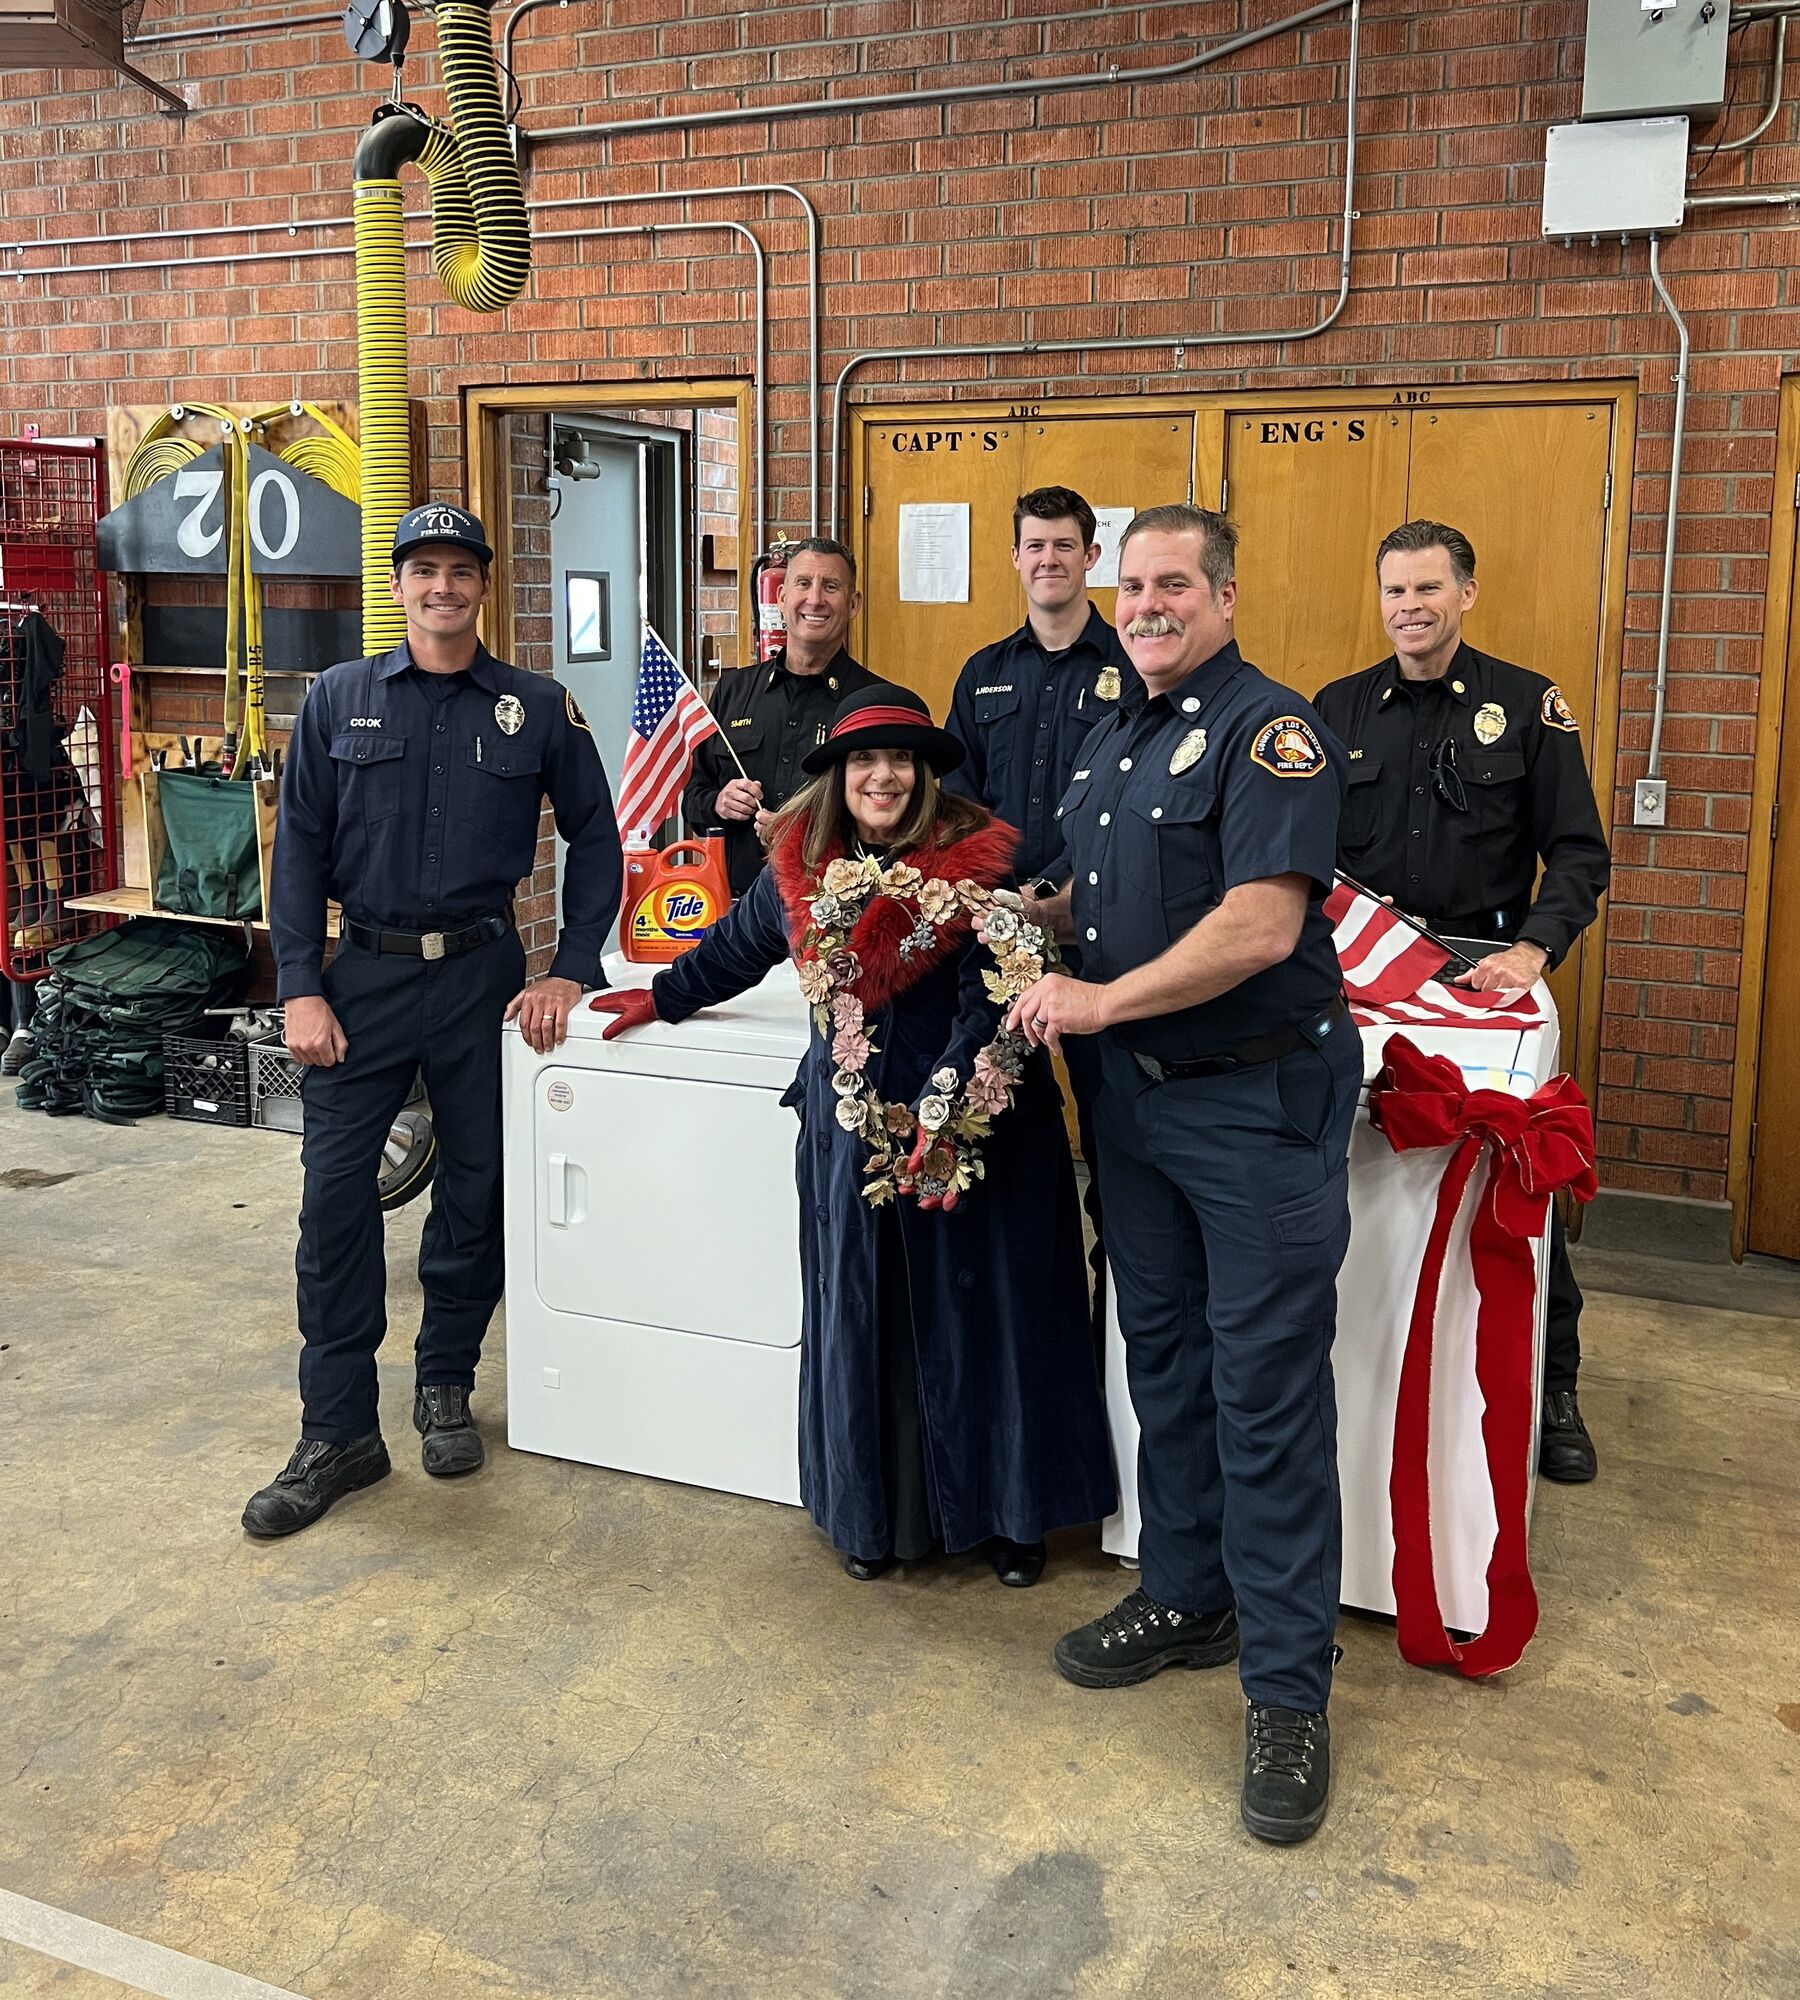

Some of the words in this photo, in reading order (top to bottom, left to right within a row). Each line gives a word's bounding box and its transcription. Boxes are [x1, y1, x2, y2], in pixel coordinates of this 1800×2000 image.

[1391, 391, 1431, 404] ABC
[1007, 405, 1041, 417] ABC
[409, 515, 420, 528] LOS
[419, 506, 447, 519] ANGELES
[447, 508, 472, 526] COUNTY
[426, 512, 454, 529] 70
[1096, 520, 1111, 528] CHE
[420, 528, 439, 537] FIRE
[975, 684, 1013, 696] ANDERSON
[350, 717, 382, 729] COOK
[730, 718, 752, 728] SMITH
[1256, 728, 1275, 752] COUNTY
[1274, 722, 1284, 731] OF
[1285, 721, 1300, 730] LOS
[1301, 726, 1322, 755] ANGELES
[1348, 749, 1363, 760] WIS
[666, 895, 704, 922] Tide
